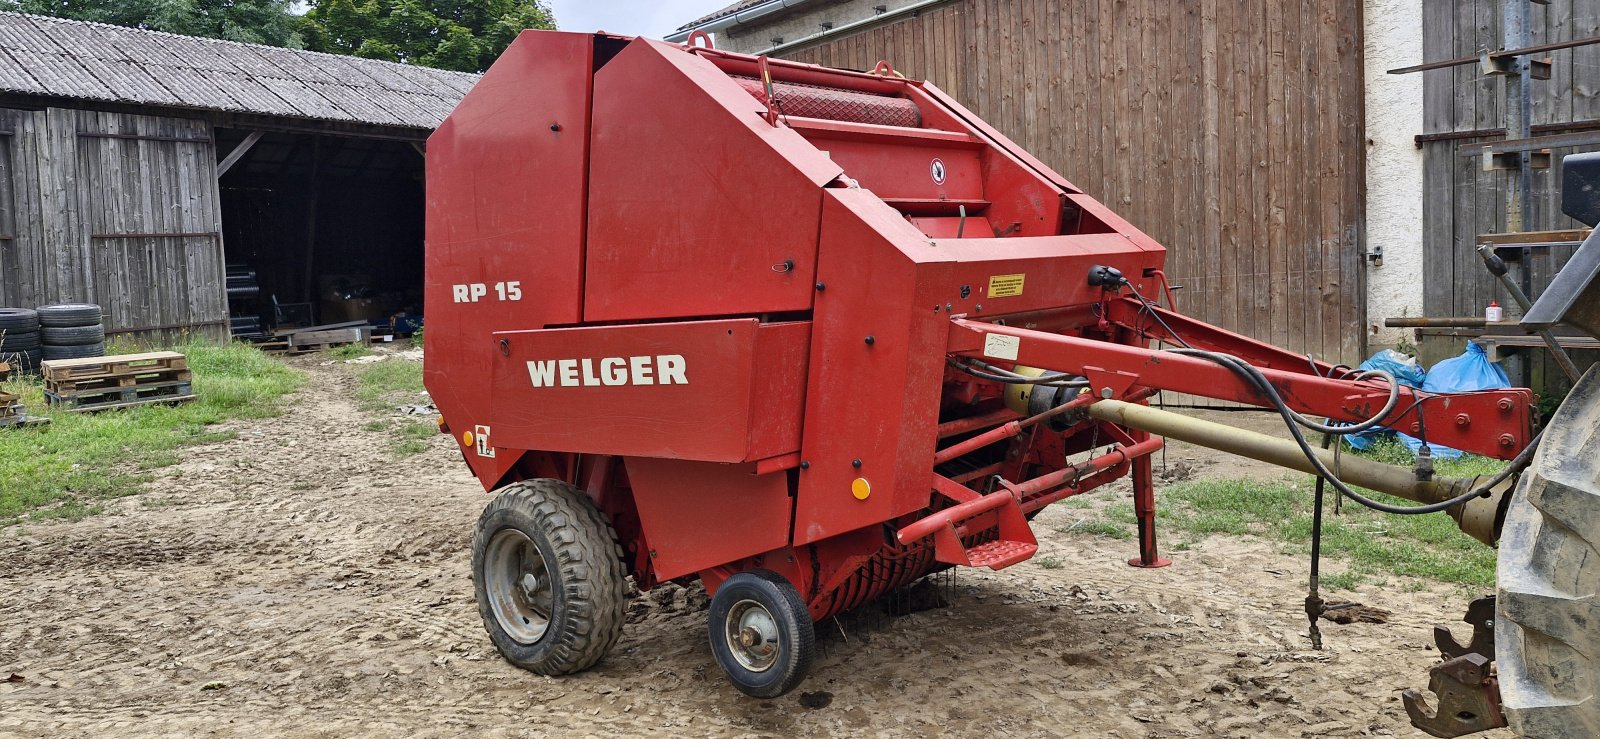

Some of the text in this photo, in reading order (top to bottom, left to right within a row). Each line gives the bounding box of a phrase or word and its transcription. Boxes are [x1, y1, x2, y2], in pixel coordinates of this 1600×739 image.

[453, 281, 521, 302] RP 15
[527, 355, 688, 387] WELGER
